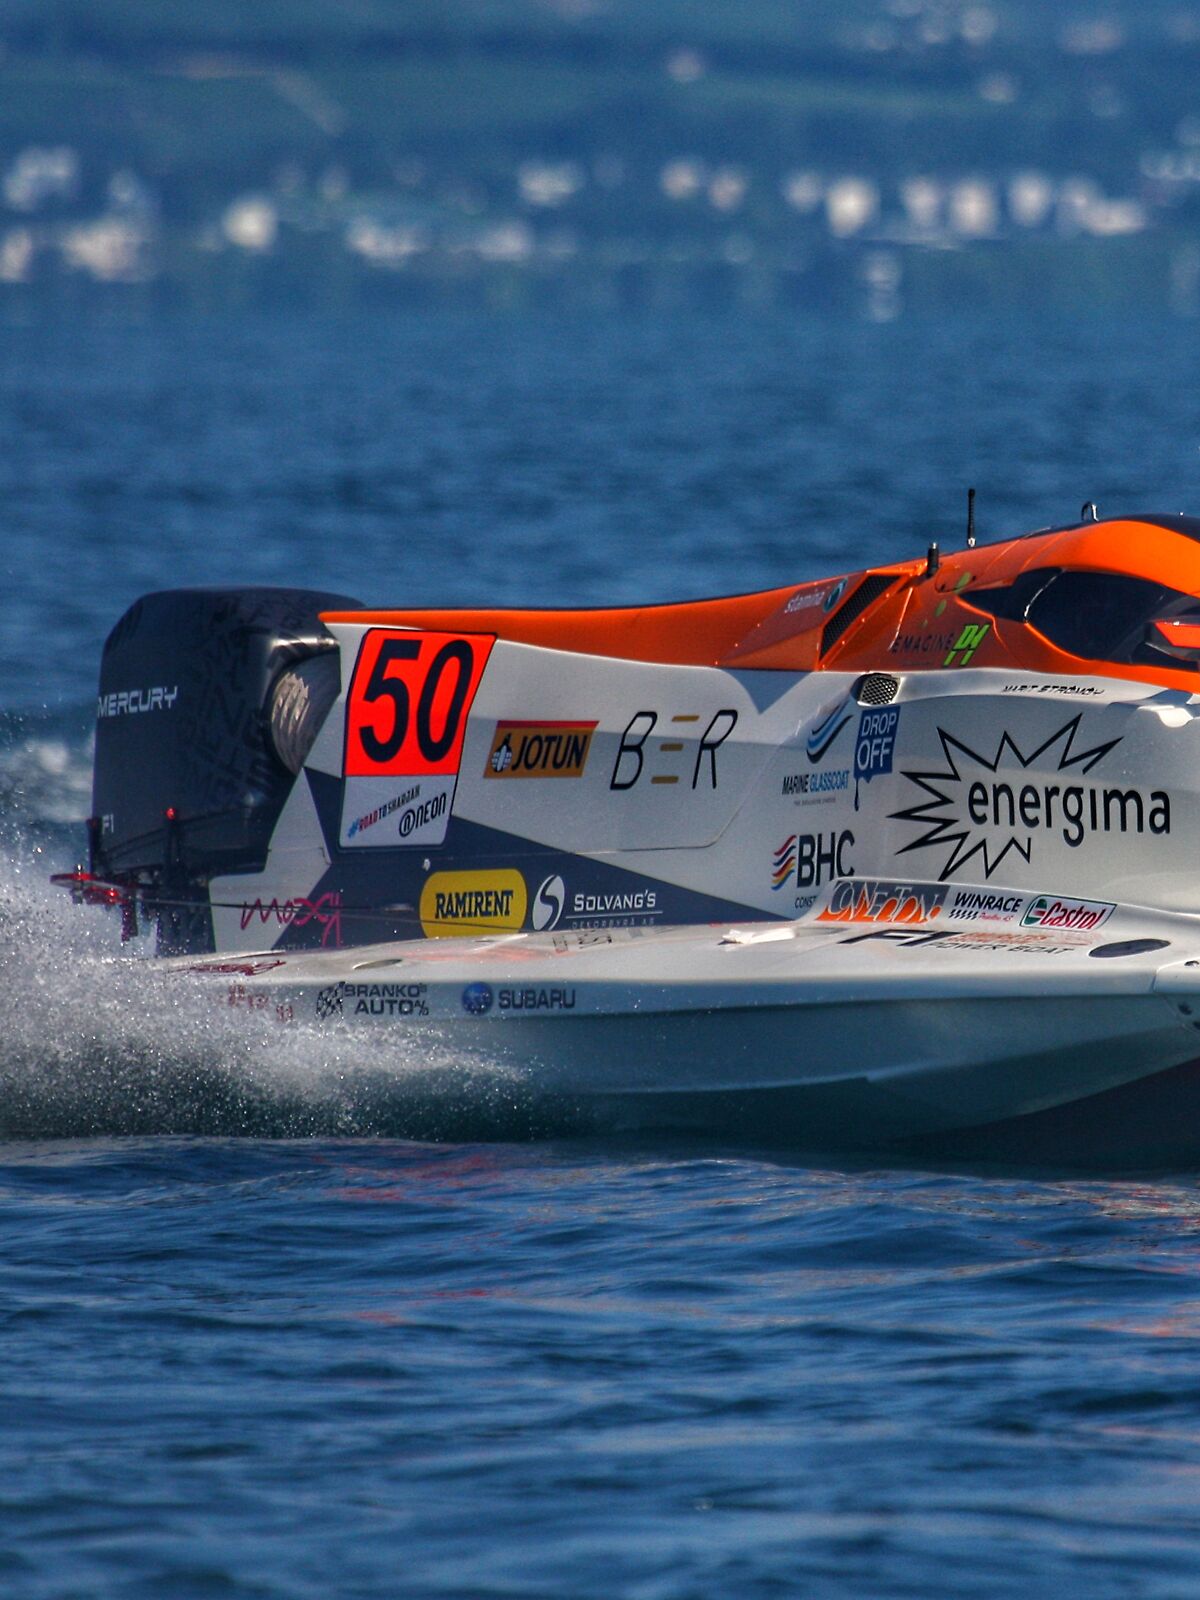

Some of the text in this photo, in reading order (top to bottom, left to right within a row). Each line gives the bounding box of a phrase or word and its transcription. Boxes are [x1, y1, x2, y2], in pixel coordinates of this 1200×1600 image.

[97, 686, 178, 718] MERCURY
[360, 639, 474, 763] 50
[861, 712, 897, 737] DROP
[511, 734, 589, 771] JOTUN
[857, 737, 892, 770] OFF
[782, 769, 850, 795] MARINE GLASSCOAT
[102, 815, 115, 834] F1
[968, 780, 1171, 848] energima
[797, 829, 855, 888] BHC
[434, 889, 514, 919] RAMIRENT
[954, 891, 1023, 912] WINRACE
[1040, 901, 1108, 929] Castrol
[498, 988, 577, 1011] SUBARU
